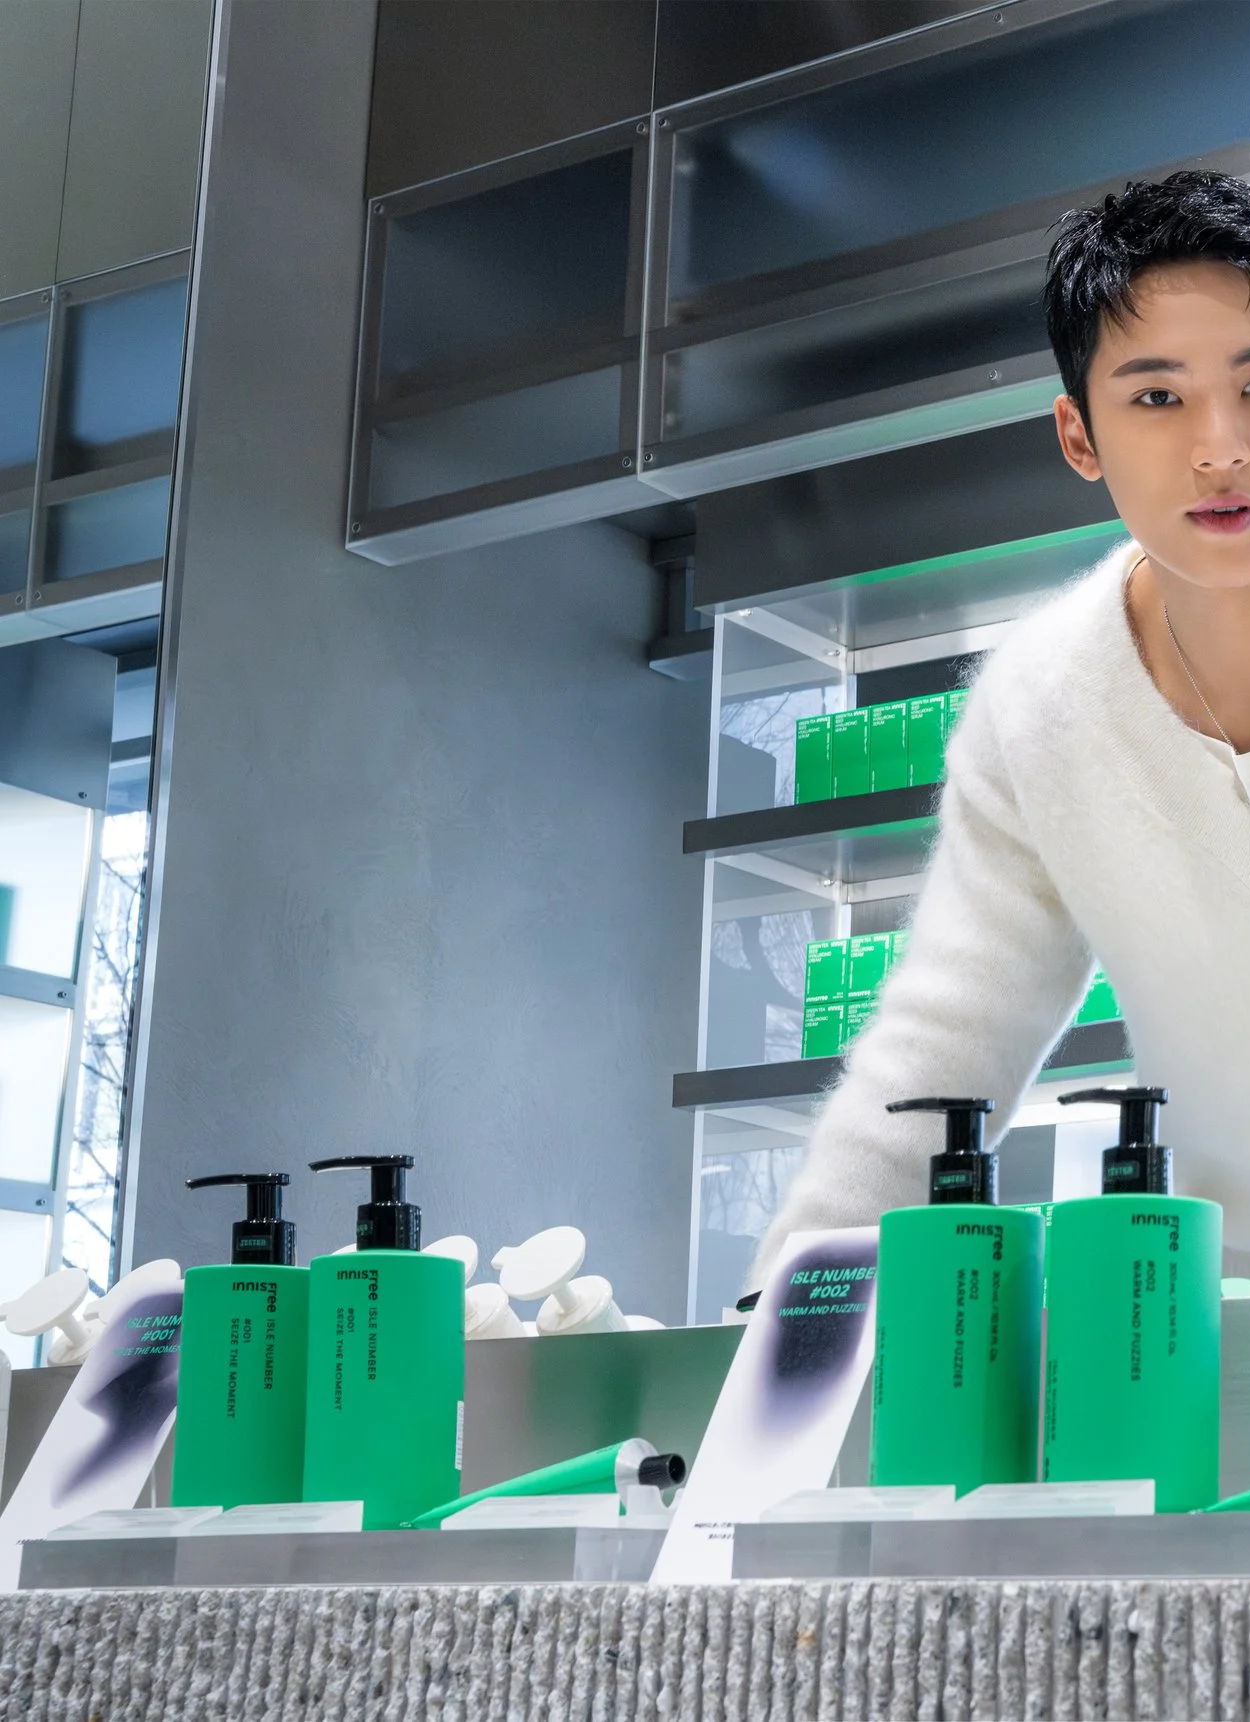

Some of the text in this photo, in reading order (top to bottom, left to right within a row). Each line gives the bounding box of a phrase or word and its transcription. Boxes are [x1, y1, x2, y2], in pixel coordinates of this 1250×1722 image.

[790, 1270, 820, 1284] ISLE
[969, 1268, 980, 1301] #002
[810, 1284, 850, 1299] #002
[126, 1316, 152, 1329] ISLE
[336, 1308, 344, 1335] SEIZE
[778, 1306, 808, 1317] WARM
[808, 1304, 828, 1315] AND
[1130, 1260, 1141, 1382] WARM AND FUZZIES
[141, 1330, 175, 1342] #001
[243, 1318, 252, 1344] #001
[953, 1268, 966, 1388] WARM AND FUZZIES
[134, 1347, 150, 1356] THE
[264, 1318, 275, 1390] ISLE NUMBER
[367, 1307, 377, 1381] ISLE NUMBER
[227, 1318, 240, 1418] SEIZE THE MOMENT
[334, 1363, 343, 1411] MOMENT
